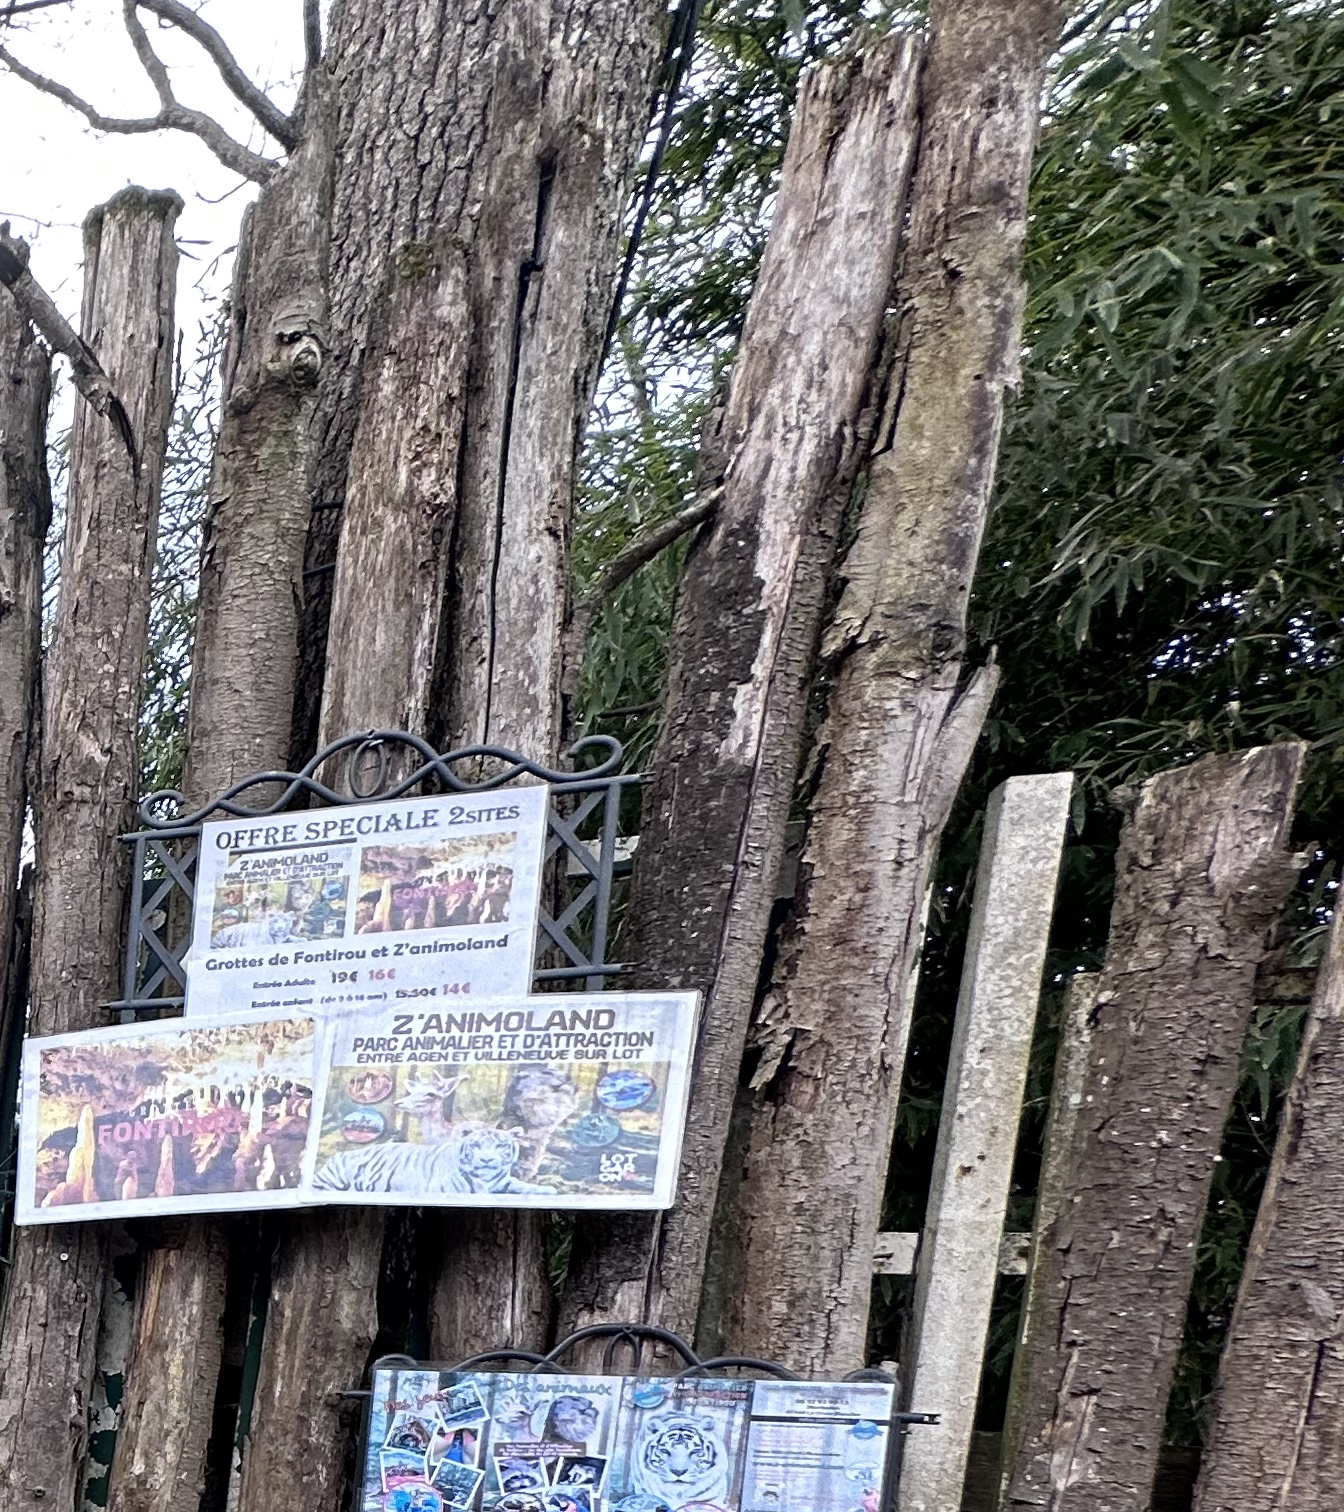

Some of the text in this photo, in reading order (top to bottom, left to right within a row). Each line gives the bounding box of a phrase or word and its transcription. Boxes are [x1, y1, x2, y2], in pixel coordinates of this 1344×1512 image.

[216, 824, 298, 850] OFFRE
[304, 808, 440, 841] SPECIALE
[205, 934, 508, 971] Grottes de Fontirou et Z'animoland
[331, 970, 358, 983] 19€
[368, 968, 396, 981] 16€
[442, 982, 471, 995] 14€
[392, 1009, 616, 1035] Z'ANIMOLAND
[352, 1031, 655, 1052] PARC ANIMALIER ET D'ATTRACTION
[357, 1048, 644, 1064] ENTRE AGEN ET VILLENEUVE SUR LOT
